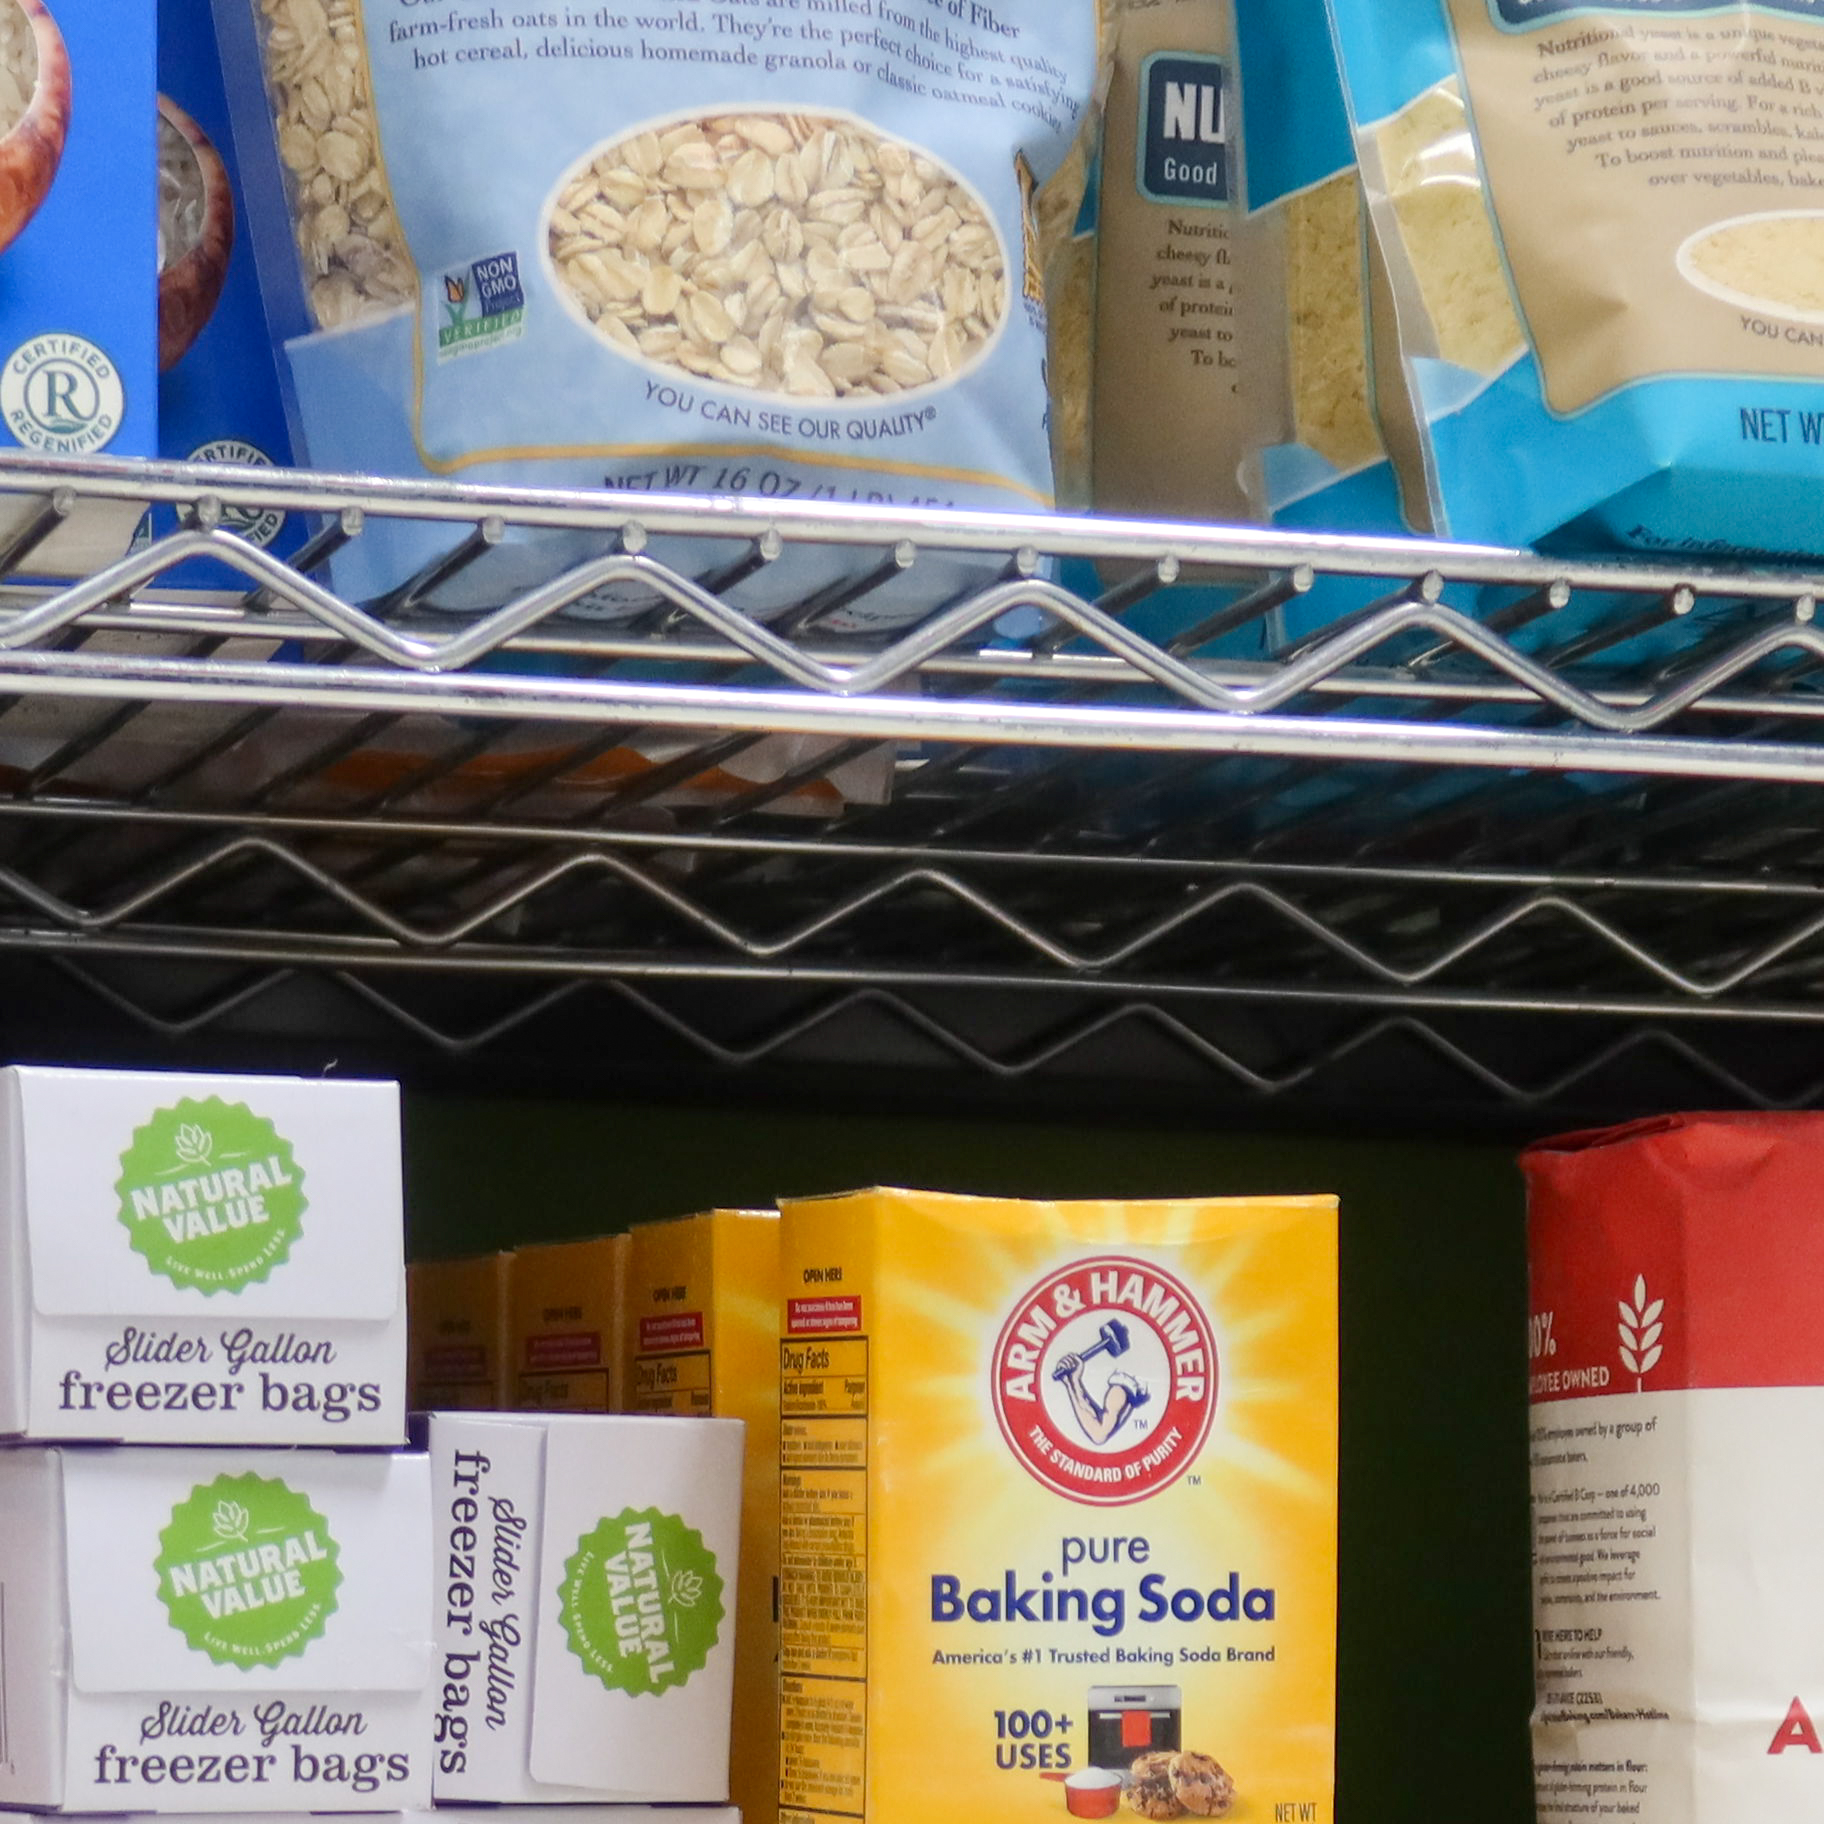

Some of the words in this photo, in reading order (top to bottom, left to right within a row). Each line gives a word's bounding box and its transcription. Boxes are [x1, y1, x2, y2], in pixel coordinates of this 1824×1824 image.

[414, 49, 448, 69] hot
[456, 39, 529, 62] cereal,
[537, 37, 633, 58] delicious
[641, 38, 757, 65] homemade
[764, 50, 846, 72] granola
[853, 59, 872, 74] or
[13, 338, 110, 379] CERTIFIED
[11, 409, 112, 452] REGENIFIED
[645, 380, 694, 413] YOU
[701, 400, 751, 427] CAN
[759, 413, 792, 435] SEE
[799, 418, 840, 439] OUR
[1740, 407, 1791, 443] NET
[129, 1154, 294, 1221] NATURAL
[162, 1195, 271, 1245] VALUE
[104, 1326, 214, 1372] Slider
[220, 1329, 338, 1370] Gallon
[1005, 1303, 1054, 1402] ARM
[1052, 1284, 1084, 1319] &
[1091, 1271, 1206, 1402] HAMMER
[58, 1370, 245, 1415] freezer
[260, 1374, 382, 1422] bags
[1029, 1425, 1048, 1455] THE
[1050, 1448, 1122, 1483] STANDARD
[1127, 1461, 1141, 1480] OF
[1144, 1427, 1183, 1472] PURITY
[443, 1449, 491, 1628] freezer
[1061, 1534, 1151, 1576] pure
[931, 1573, 1126, 1637] Baking
[1140, 1572, 1276, 1621] Soda
[932, 1648, 1018, 1666] America's
[1022, 1648, 1043, 1664] #1
[1048, 1647, 1110, 1664] Trusted
[1115, 1648, 1174, 1667] Baking
[1179, 1647, 1221, 1664] Soda
[1226, 1646, 1276, 1663] Brand
[434, 1635, 480, 1777] bags
[994, 1710, 1074, 1739] 100+
[996, 1743, 1072, 1769] USES
